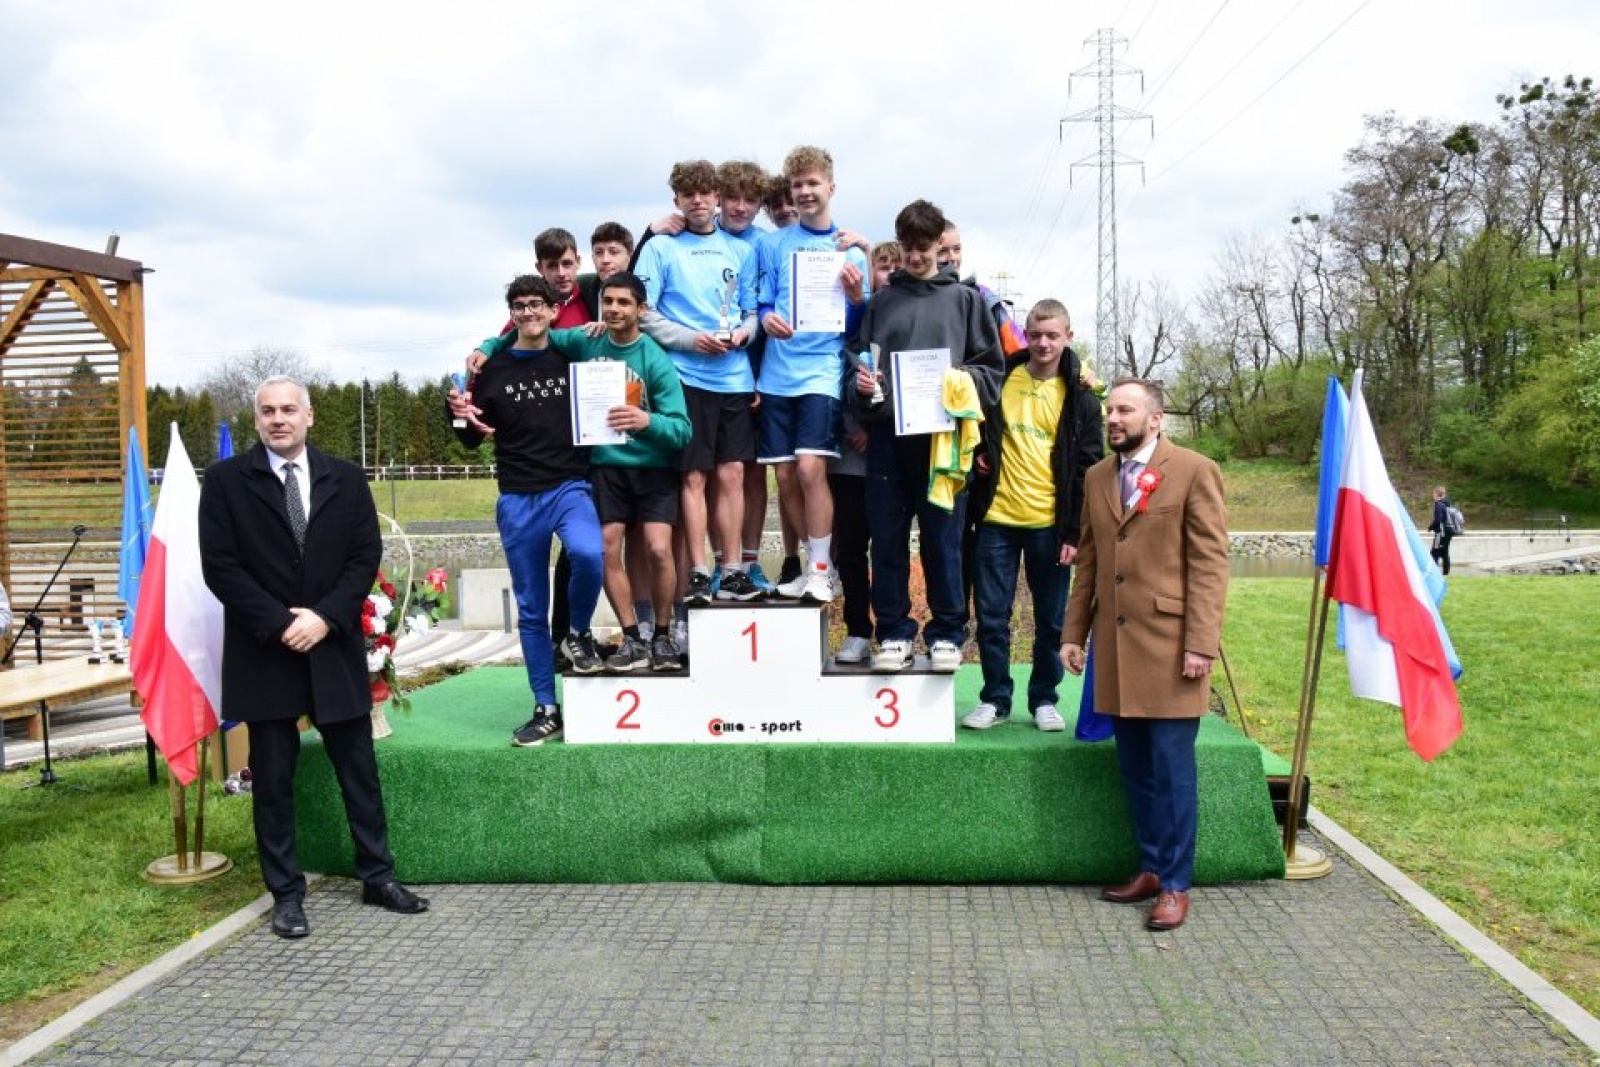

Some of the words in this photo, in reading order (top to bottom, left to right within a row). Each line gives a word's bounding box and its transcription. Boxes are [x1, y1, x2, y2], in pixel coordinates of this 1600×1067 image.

[741, 622, 758, 662] 1
[615, 690, 641, 729] 2
[761, 719, 802, 735] sport
[874, 688, 900, 728] 3
